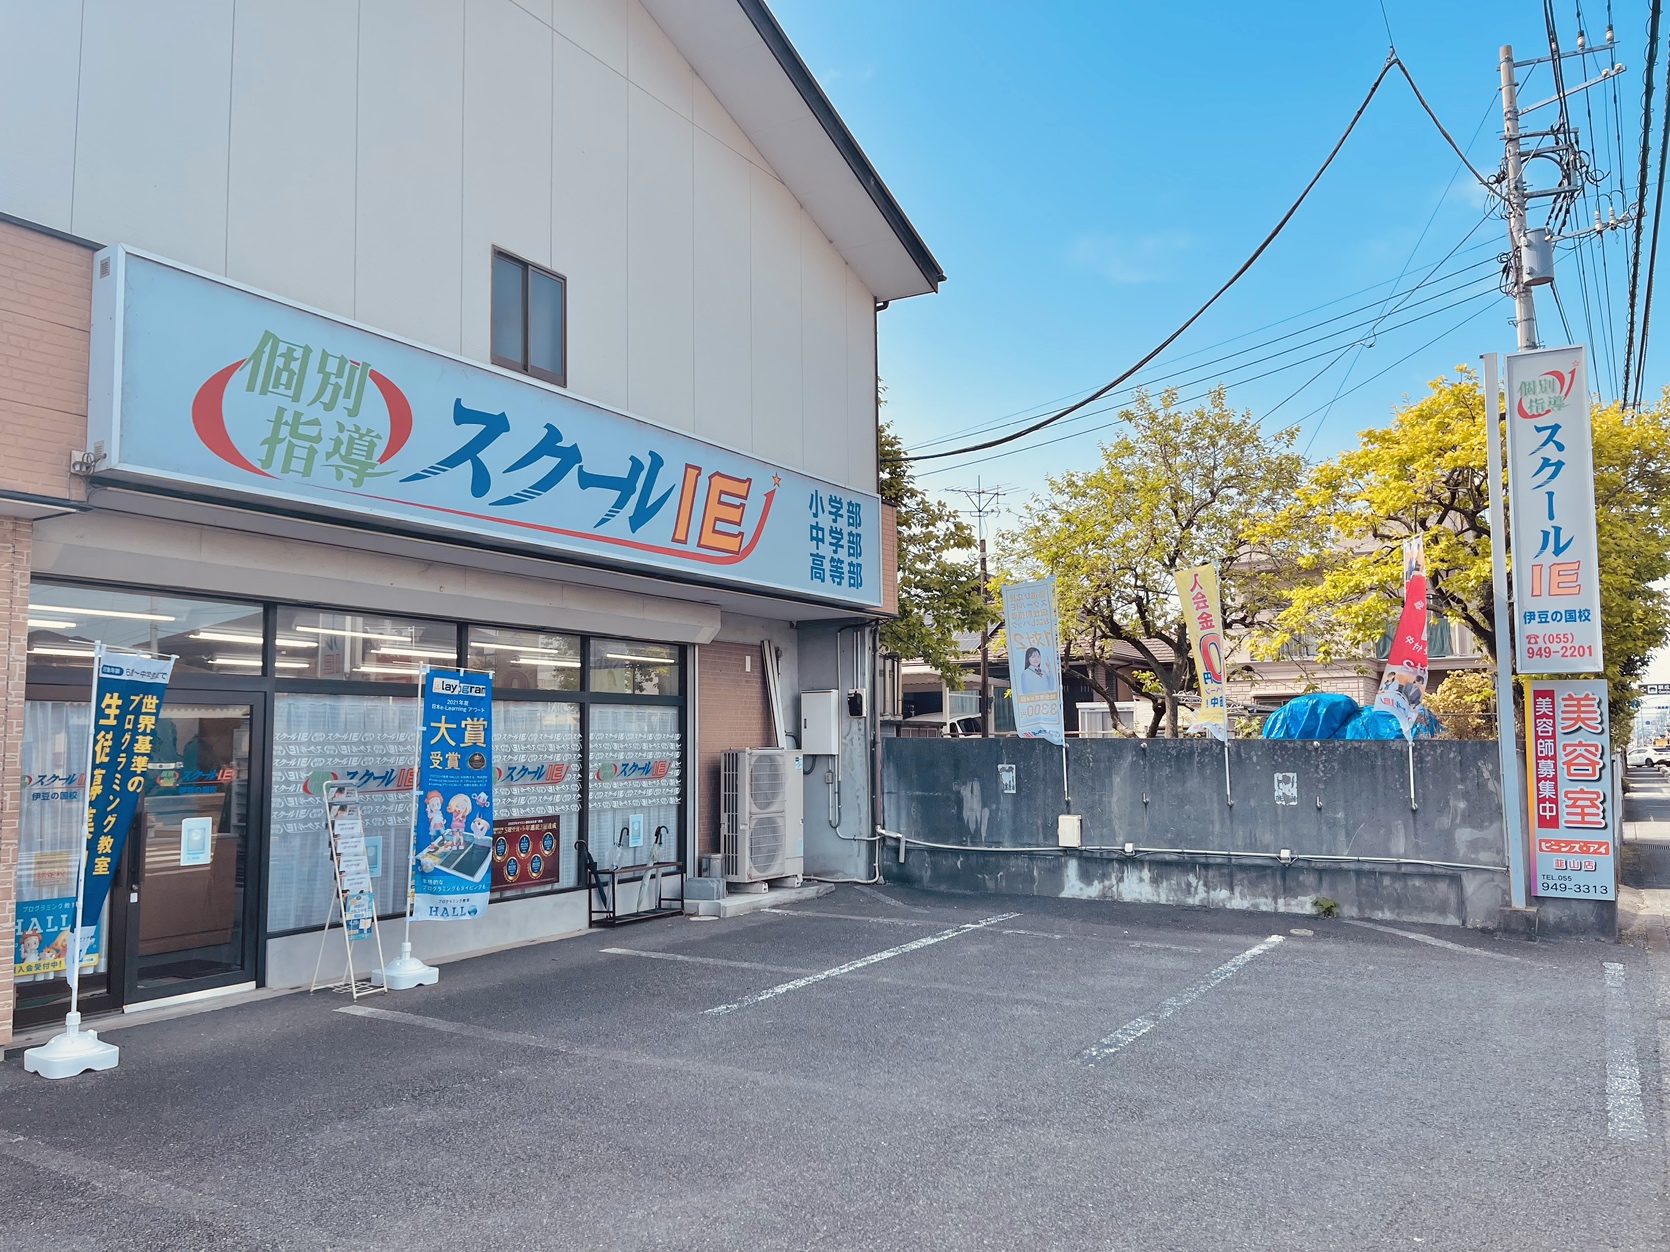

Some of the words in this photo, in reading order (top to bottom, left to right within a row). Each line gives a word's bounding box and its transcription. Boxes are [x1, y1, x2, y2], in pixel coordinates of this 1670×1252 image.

[239, 329, 371, 418] 個別
[1517, 378, 1555, 397] 個別
[1527, 394, 1571, 414] 指導
[257, 405, 399, 488] 指導
[808, 489, 863, 530] 小学部
[808, 522, 863, 560] 中学部
[809, 552, 863, 590] 高等部
[1523, 608, 1591, 625] 伊豆の国校
[1527, 644, 1593, 659] 949-2201
[1542, 632, 1575, 645] (055)
[127, 694, 160, 793] 世界基準の
[430, 715, 488, 748] 大賞
[429, 751, 461, 770] 受賞
[501, 764, 565, 783] スクールIE
[1535, 697, 1556, 820] 美容師募集中
[1560, 692, 1605, 827] 美容室
[32, 791, 78, 801] 伊豆の国校
[85, 692, 122, 869] 生徒募集
[92, 693, 143, 876] プログラミング教室
[1541, 841, 1608, 854] ビーンズ・アイ
[1541, 882, 1608, 895] 949-3313
